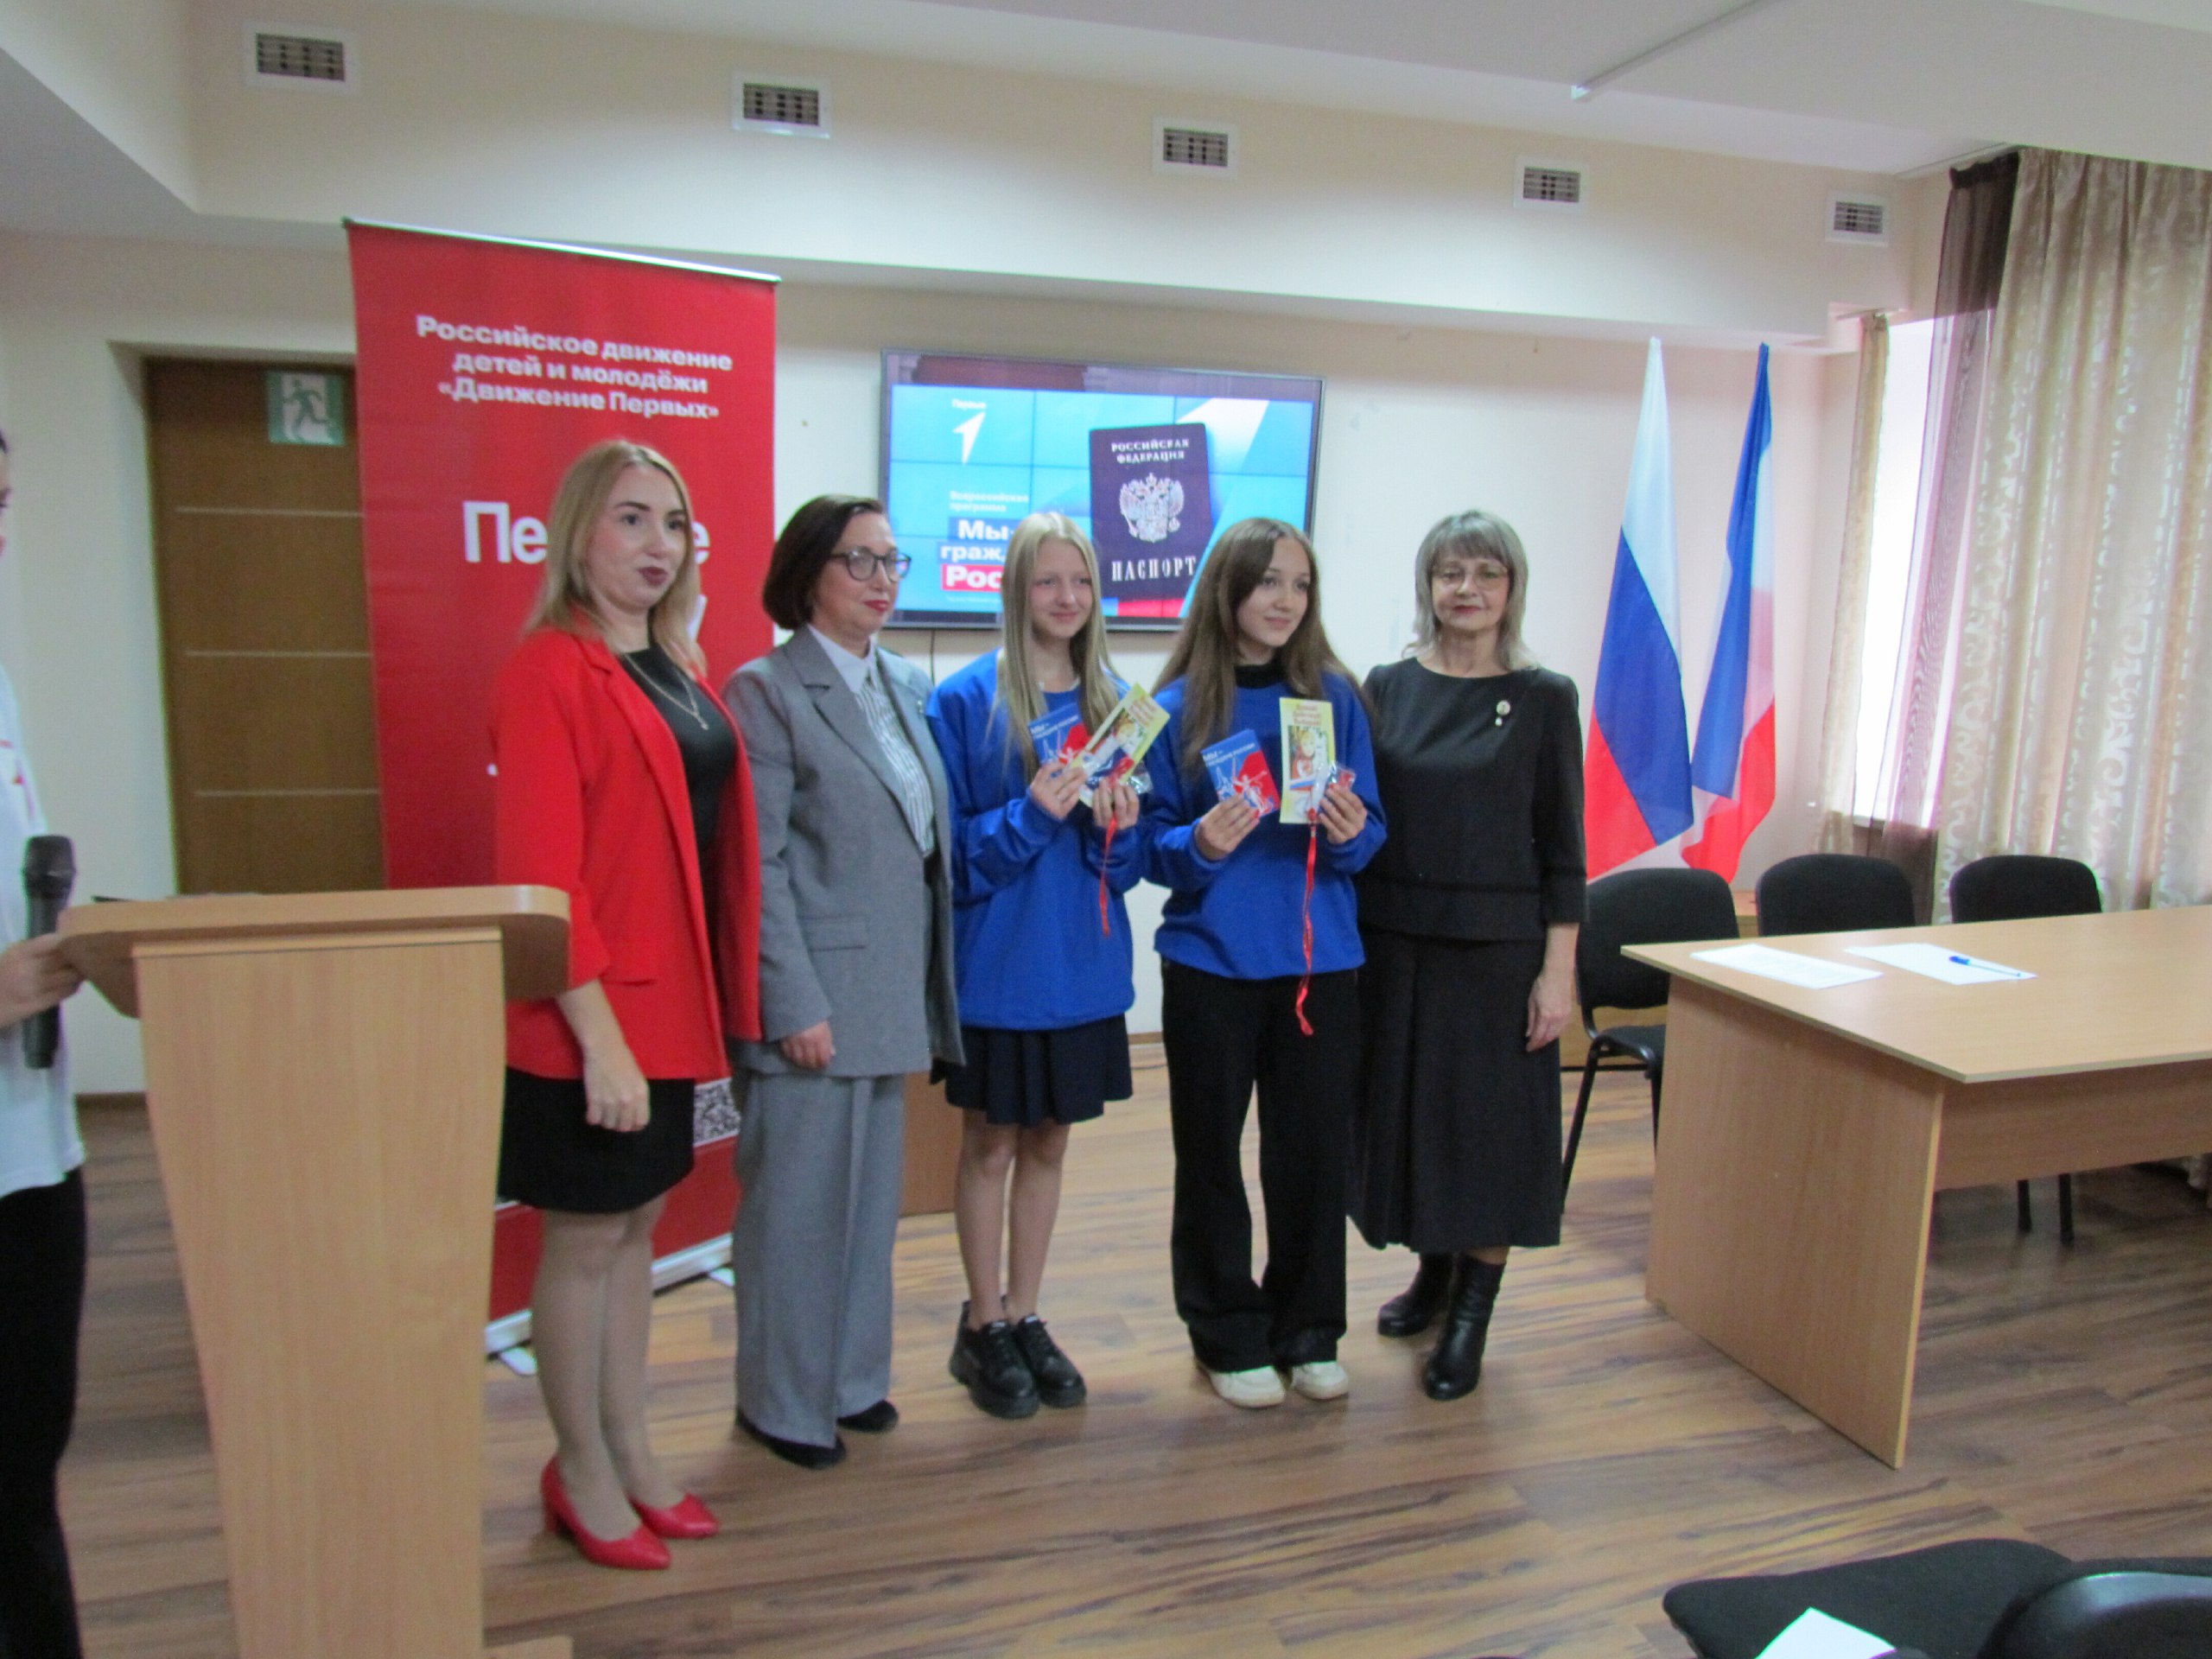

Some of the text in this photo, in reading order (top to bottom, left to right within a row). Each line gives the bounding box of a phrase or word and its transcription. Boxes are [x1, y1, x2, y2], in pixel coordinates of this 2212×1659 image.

[416, 315, 733, 371] Российское движение
[452, 353, 709, 393] детей и молодёжи
[438, 376, 720, 418] «Движение Первых»
[1111, 439, 1189, 452] РОССИЙСКАЯ
[1116, 450, 1185, 463] ФЕДЕРАЦИЯ
[462, 500, 710, 564] Пее
[957, 519, 1009, 540] Мы
[940, 545, 1006, 563] граж
[945, 565, 1002, 588] Рос
[1112, 556, 1196, 582] ПАСПОРТ
